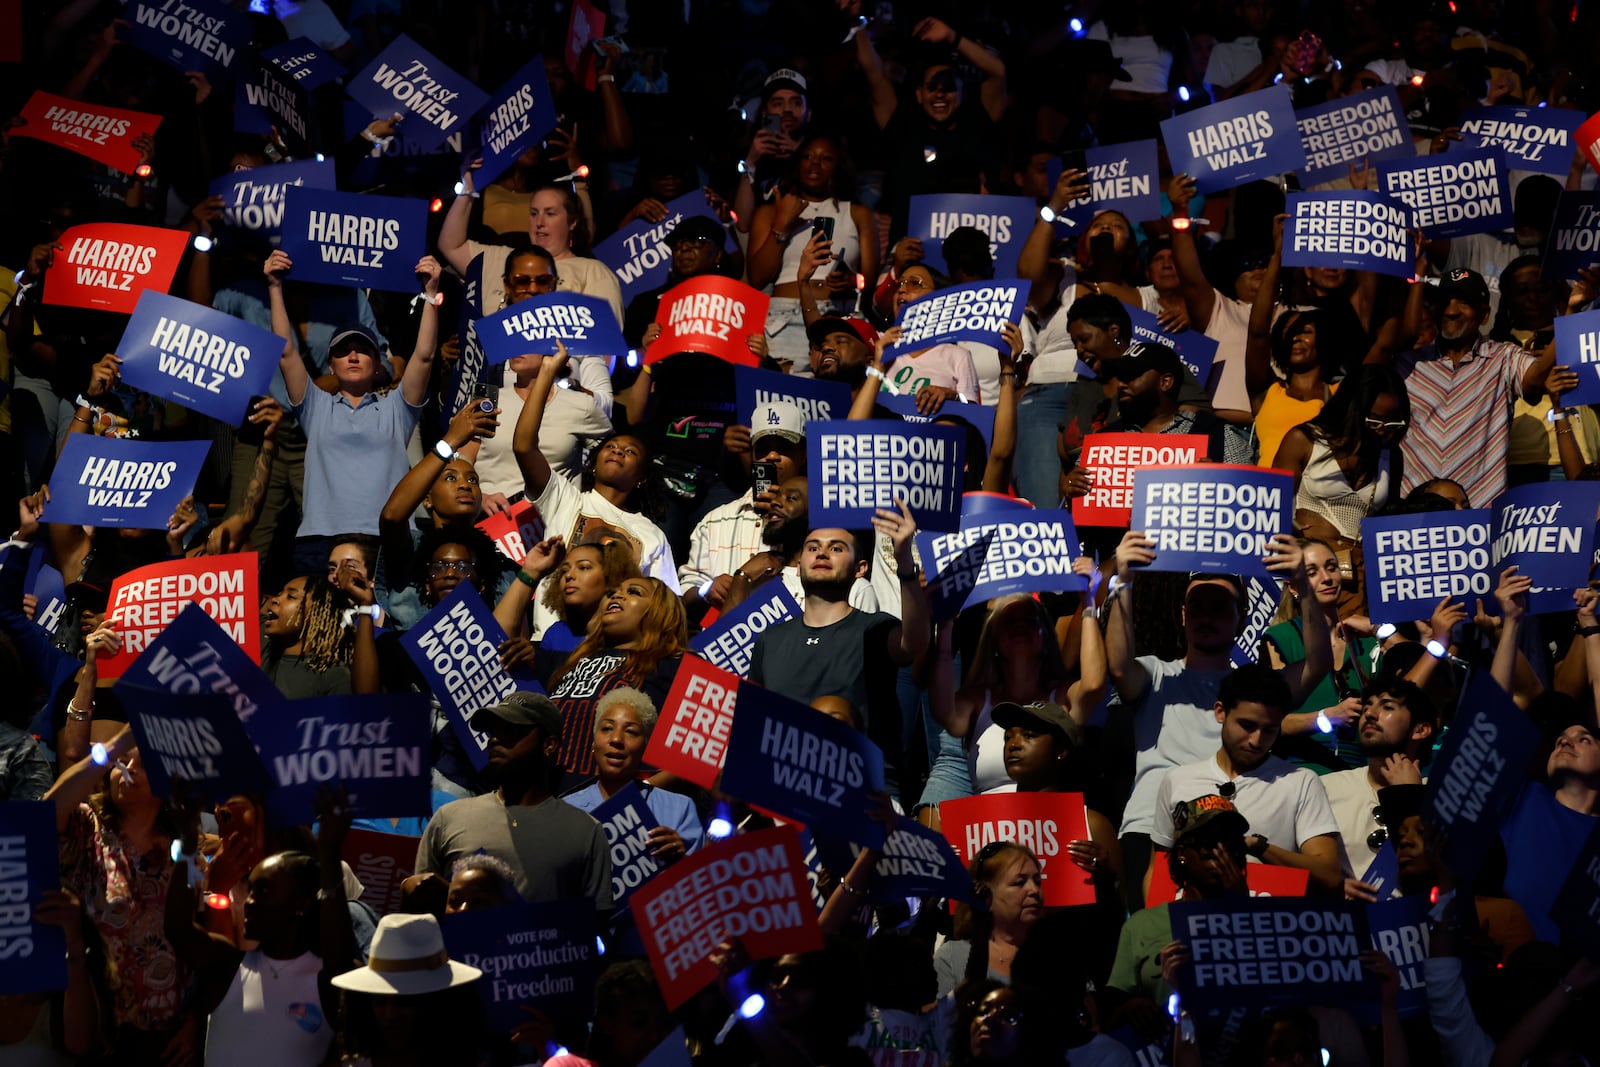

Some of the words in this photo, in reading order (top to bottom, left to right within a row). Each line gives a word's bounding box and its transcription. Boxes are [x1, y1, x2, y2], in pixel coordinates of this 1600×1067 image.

[136, 3, 236, 68] WOMEN
[372, 62, 459, 131] WOMEN
[401, 59, 460, 105] Trust
[44, 105, 132, 137] HARRIS
[246, 83, 306, 141] WOMEN
[481, 83, 535, 147] HARRIS
[1297, 96, 1392, 135] FREEDOM
[51, 121, 107, 146] WALZ
[489, 115, 532, 156] WALZ
[1188, 110, 1274, 158] HARRIS
[1302, 113, 1398, 153] FREEDOM
[1461, 119, 1569, 147] WOMEN
[1206, 140, 1267, 172] WALZ
[1304, 129, 1403, 173] FREEDOM
[1086, 157, 1129, 180] rust
[1386, 158, 1497, 191] FREEDOM
[224, 202, 286, 230] WOM
[1297, 200, 1407, 227] FREEDOM
[307, 210, 400, 251] HARRIS
[1295, 218, 1408, 245] FREEDOM
[68, 237, 157, 275] HARRIS
[320, 245, 384, 269] WALZ
[1294, 236, 1407, 262] FREEDOM
[76, 267, 133, 292] WALZ
[669, 293, 746, 329] HARRIS
[899, 302, 1013, 331] FREEDOM
[905, 287, 1018, 316] FREEDOM
[502, 304, 596, 336] HARRIS
[521, 326, 587, 341] WALZ
[675, 321, 729, 341] WALZ
[894, 316, 1008, 348] FREEDOM
[150, 317, 250, 379] HARRIS
[1134, 325, 1159, 342] VOTE
[1157, 334, 1176, 349] FOR
[158, 353, 226, 394] WALZ
[767, 408, 780, 425] LA
[821, 435, 945, 462] FREEDOM
[1086, 446, 1196, 466] FREEDOM
[79, 456, 177, 490] HARRIS
[821, 459, 944, 485] FREEDOM
[87, 488, 153, 508] WALZ
[821, 484, 942, 512] FREEDOM
[1146, 482, 1281, 510] FREEDOM
[1145, 506, 1281, 533] FREEDOM
[1500, 500, 1562, 533] Trust
[932, 521, 1065, 559] FREEDOM
[936, 540, 1069, 578] FREEDOM
[1378, 547, 1489, 578] FREEDO
[114, 569, 244, 608] FREEDOM
[941, 557, 1072, 600] FREEDOM
[1380, 572, 1491, 602] FREEDO
[697, 595, 788, 665] EEDOM
[184, 640, 259, 717] Trust
[139, 712, 223, 759] HARRIS
[296, 714, 393, 751] Trust
[273, 745, 421, 787] WOMEN
[760, 717, 865, 789] HARRIS
[1434, 712, 1499, 825] HARRIS
[773, 763, 847, 808] WALZ
[1460, 751, 1506, 824] WALZ
[875, 857, 946, 880] WALZ
[645, 844, 790, 928] FREEDOM
[653, 872, 797, 955] FREEDOM
[1188, 911, 1356, 936] FREEDOM
[506, 930, 534, 946] VOTE
[534, 927, 559, 943] FOR
[663, 901, 802, 982] FREEDOM
[1191, 935, 1359, 961] FREEDOM
[465, 943, 590, 978] Reproductive
[1194, 959, 1363, 988] FREEDOM
[491, 973, 576, 1003] Freedom
